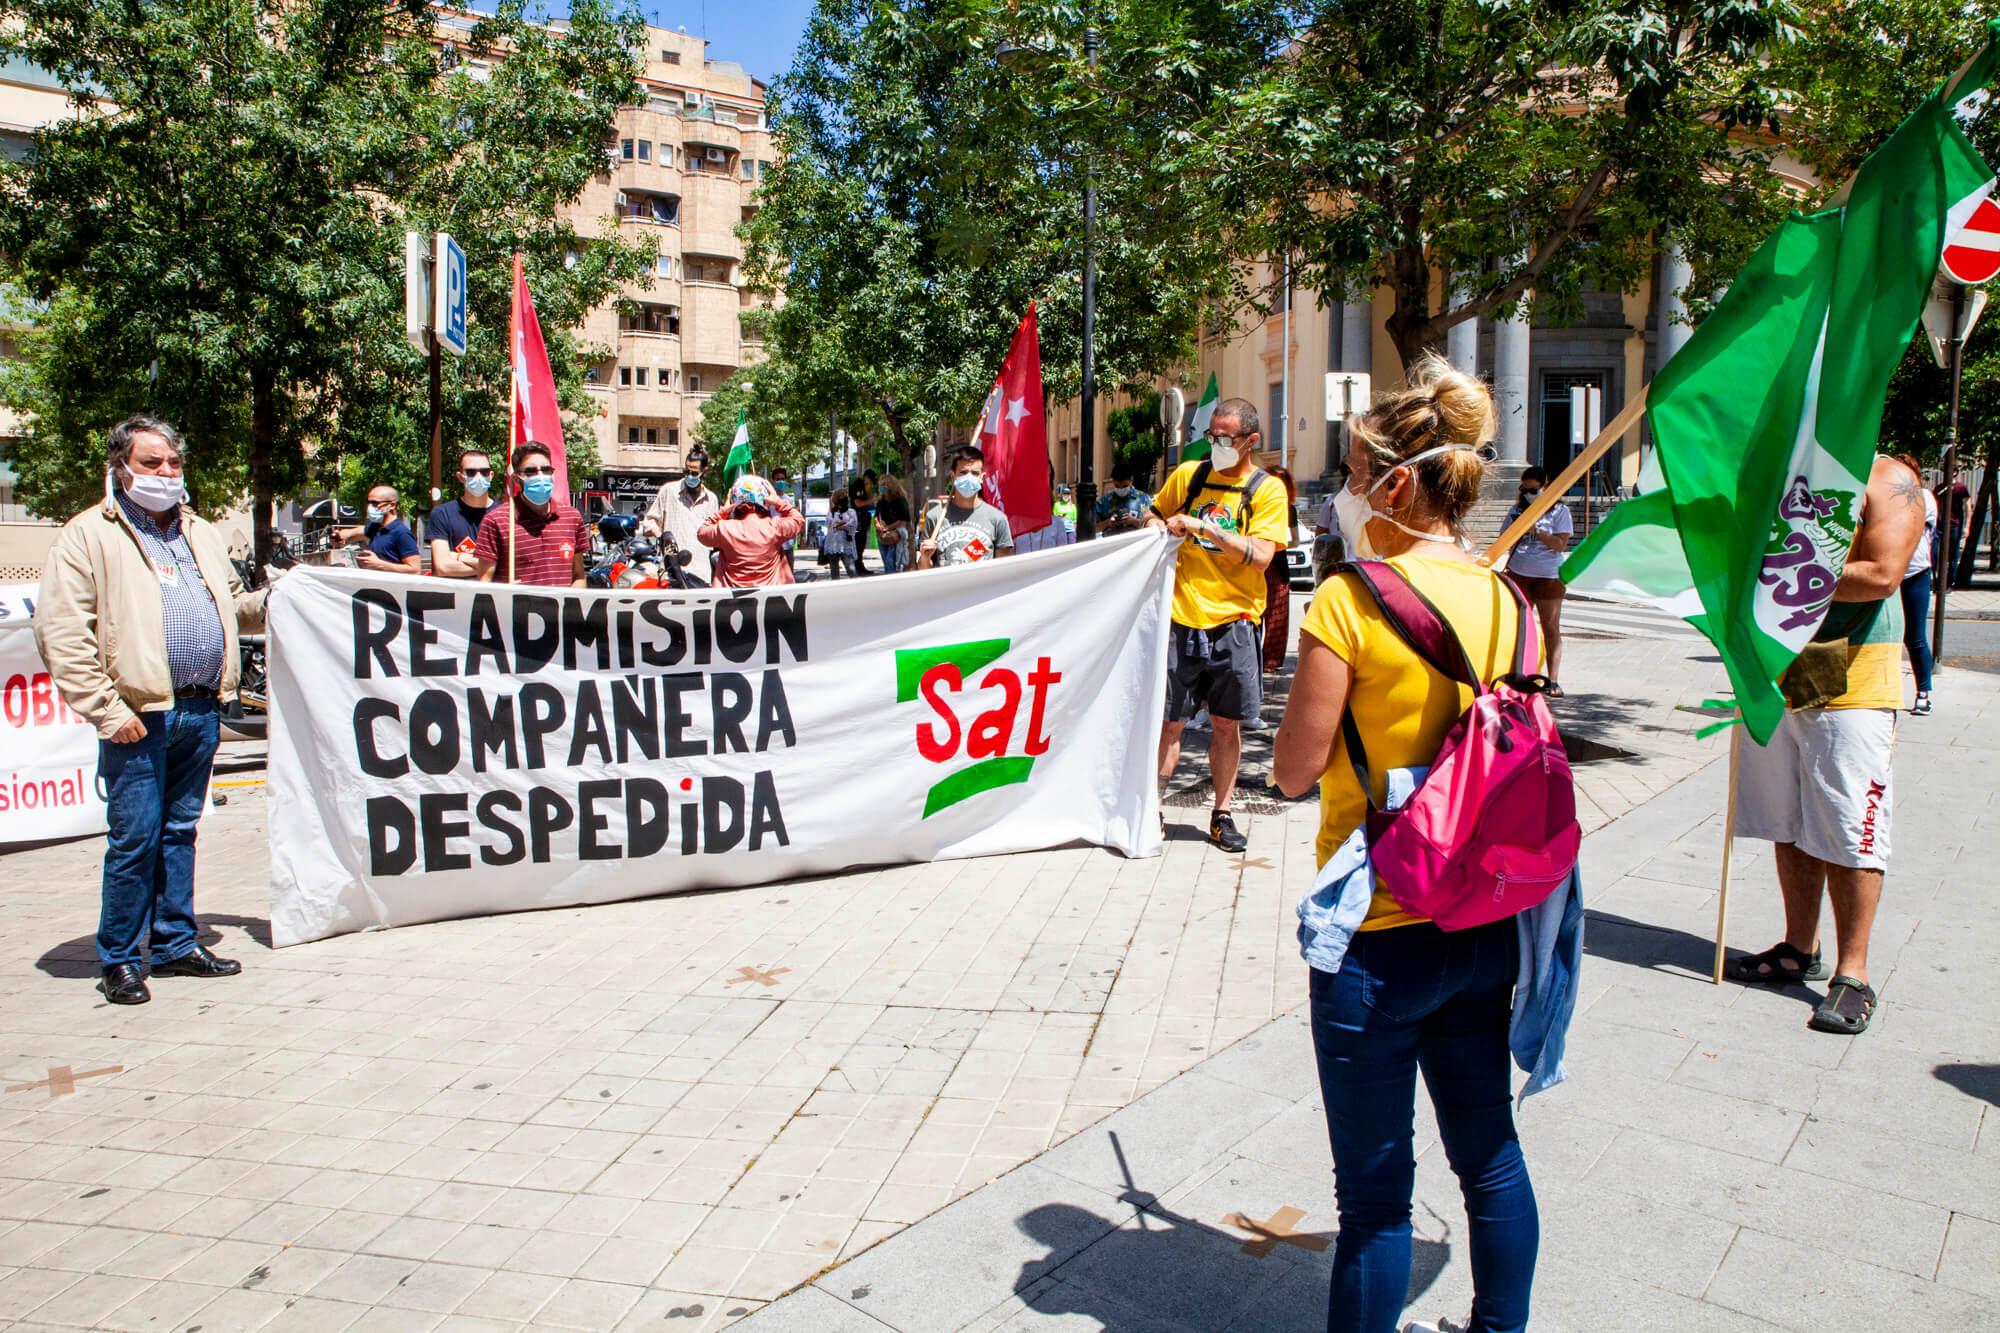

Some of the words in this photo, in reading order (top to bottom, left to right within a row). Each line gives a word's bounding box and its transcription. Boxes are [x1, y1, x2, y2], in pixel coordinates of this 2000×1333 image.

[448, 247, 461, 331] P
[353, 669, 797, 779] COMPAÑERA
[1856, 798, 1879, 856] Hurley
